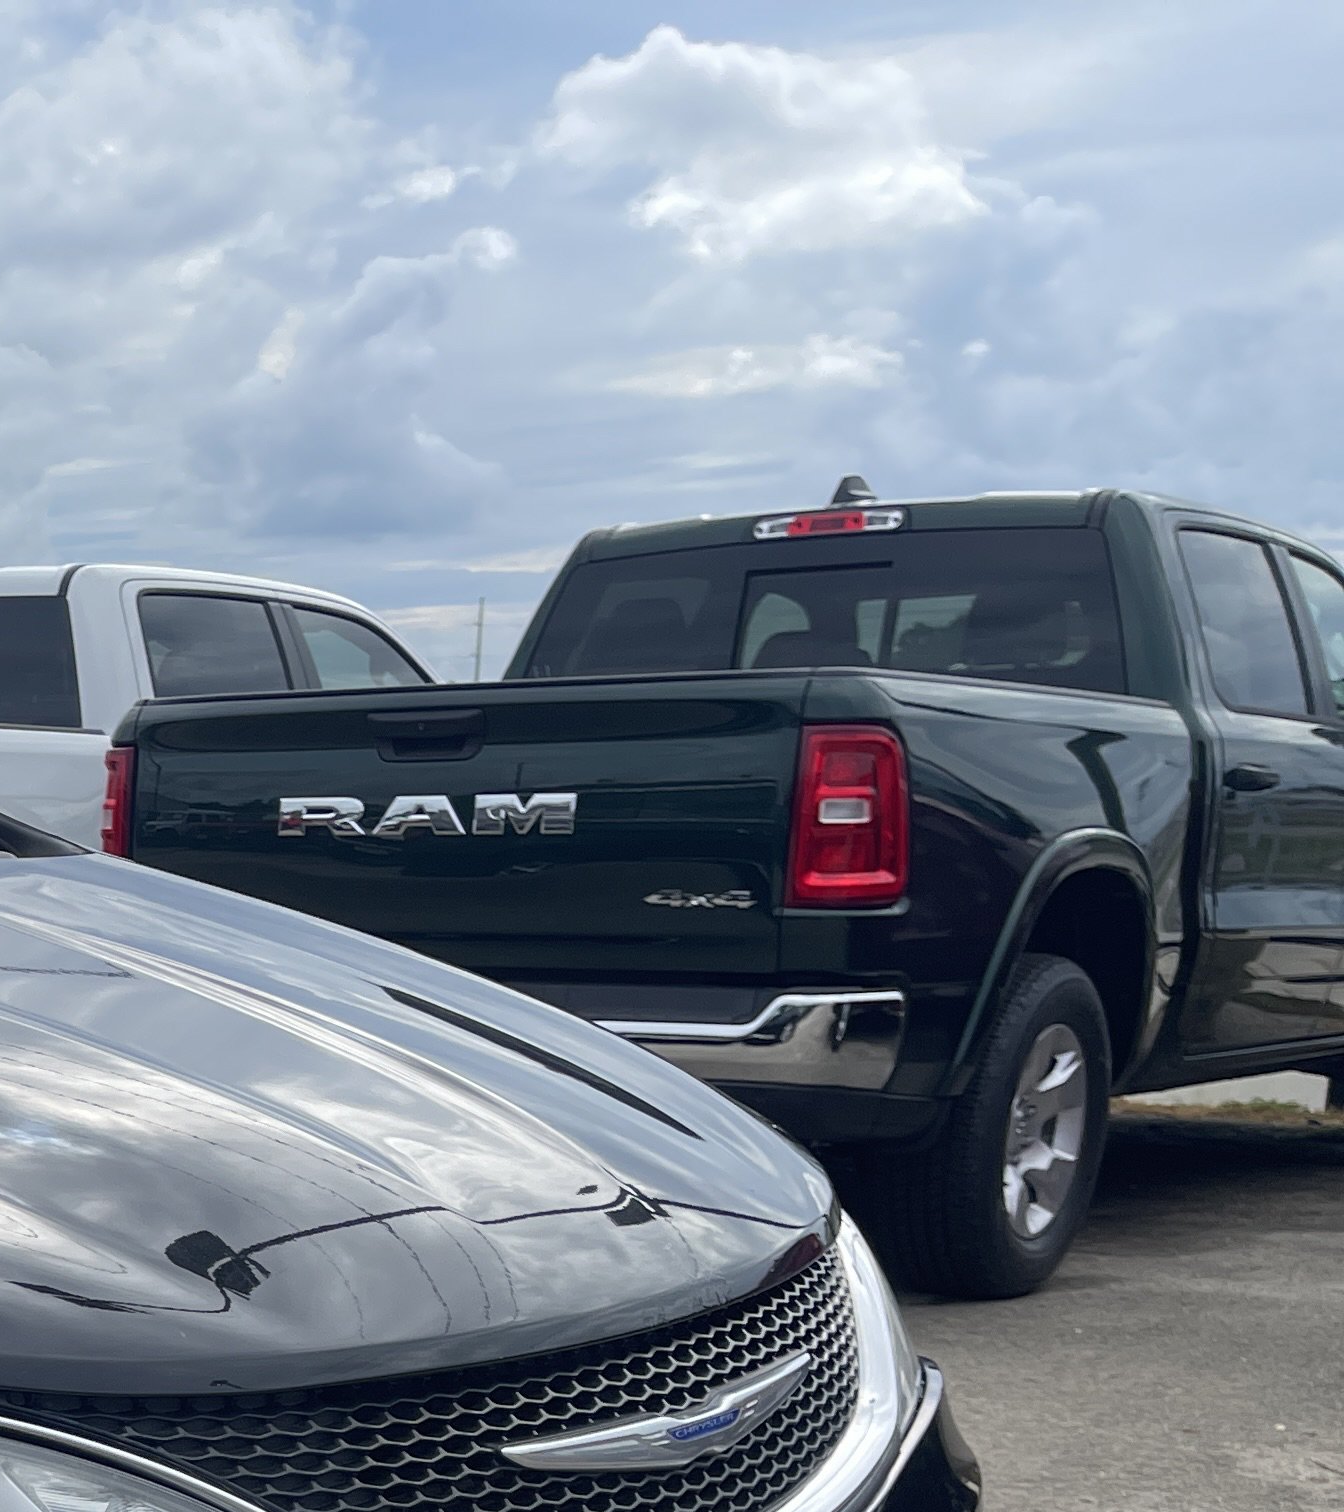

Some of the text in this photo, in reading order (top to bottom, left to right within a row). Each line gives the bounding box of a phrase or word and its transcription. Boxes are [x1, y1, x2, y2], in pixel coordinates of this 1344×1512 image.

[277, 793, 578, 840] RAM
[642, 888, 758, 909] 4x4
[675, 1413, 734, 1437] CHRYSLER
